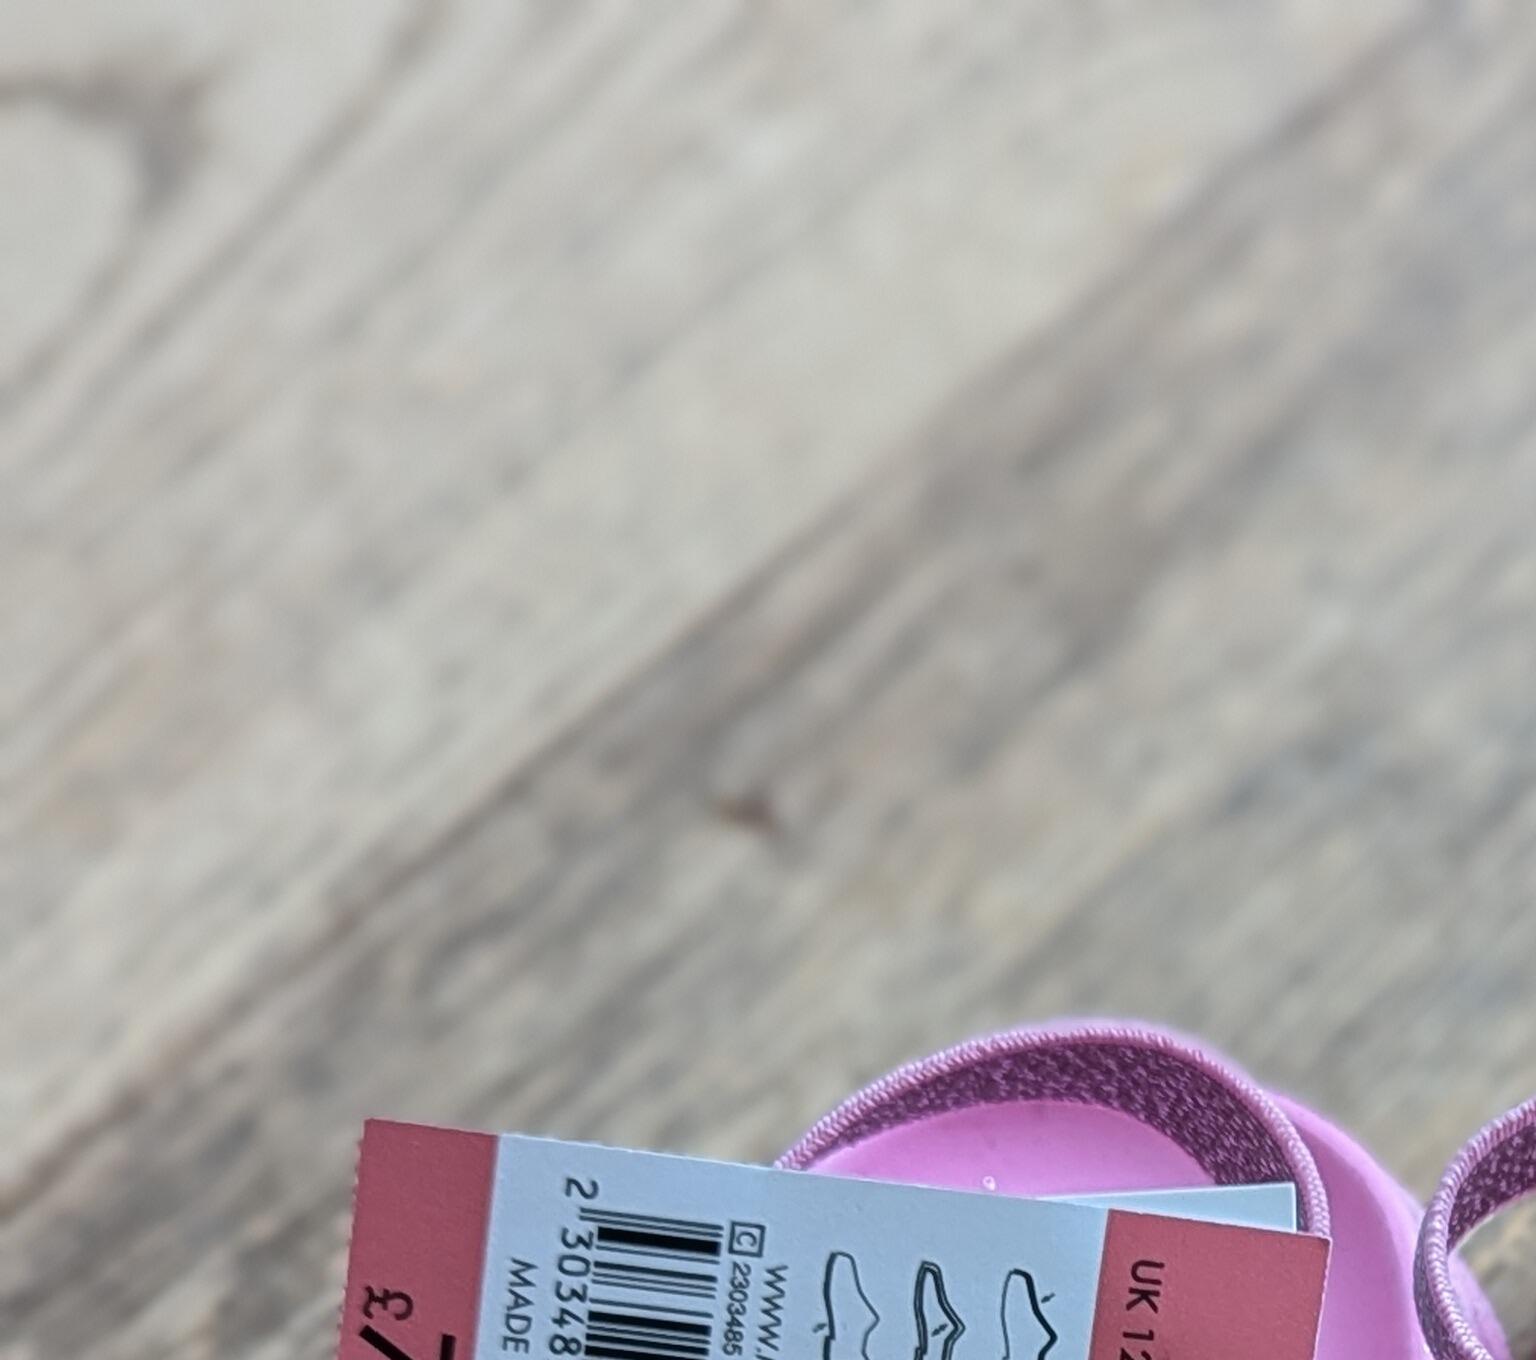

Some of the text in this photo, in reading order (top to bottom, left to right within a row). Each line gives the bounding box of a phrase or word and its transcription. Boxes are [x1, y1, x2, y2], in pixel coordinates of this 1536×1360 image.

[564, 1178, 599, 1200] 2
[498, 1258, 538, 1356] MADE
[722, 1261, 752, 1356] 2303485
[1125, 1258, 1166, 1313] UK
